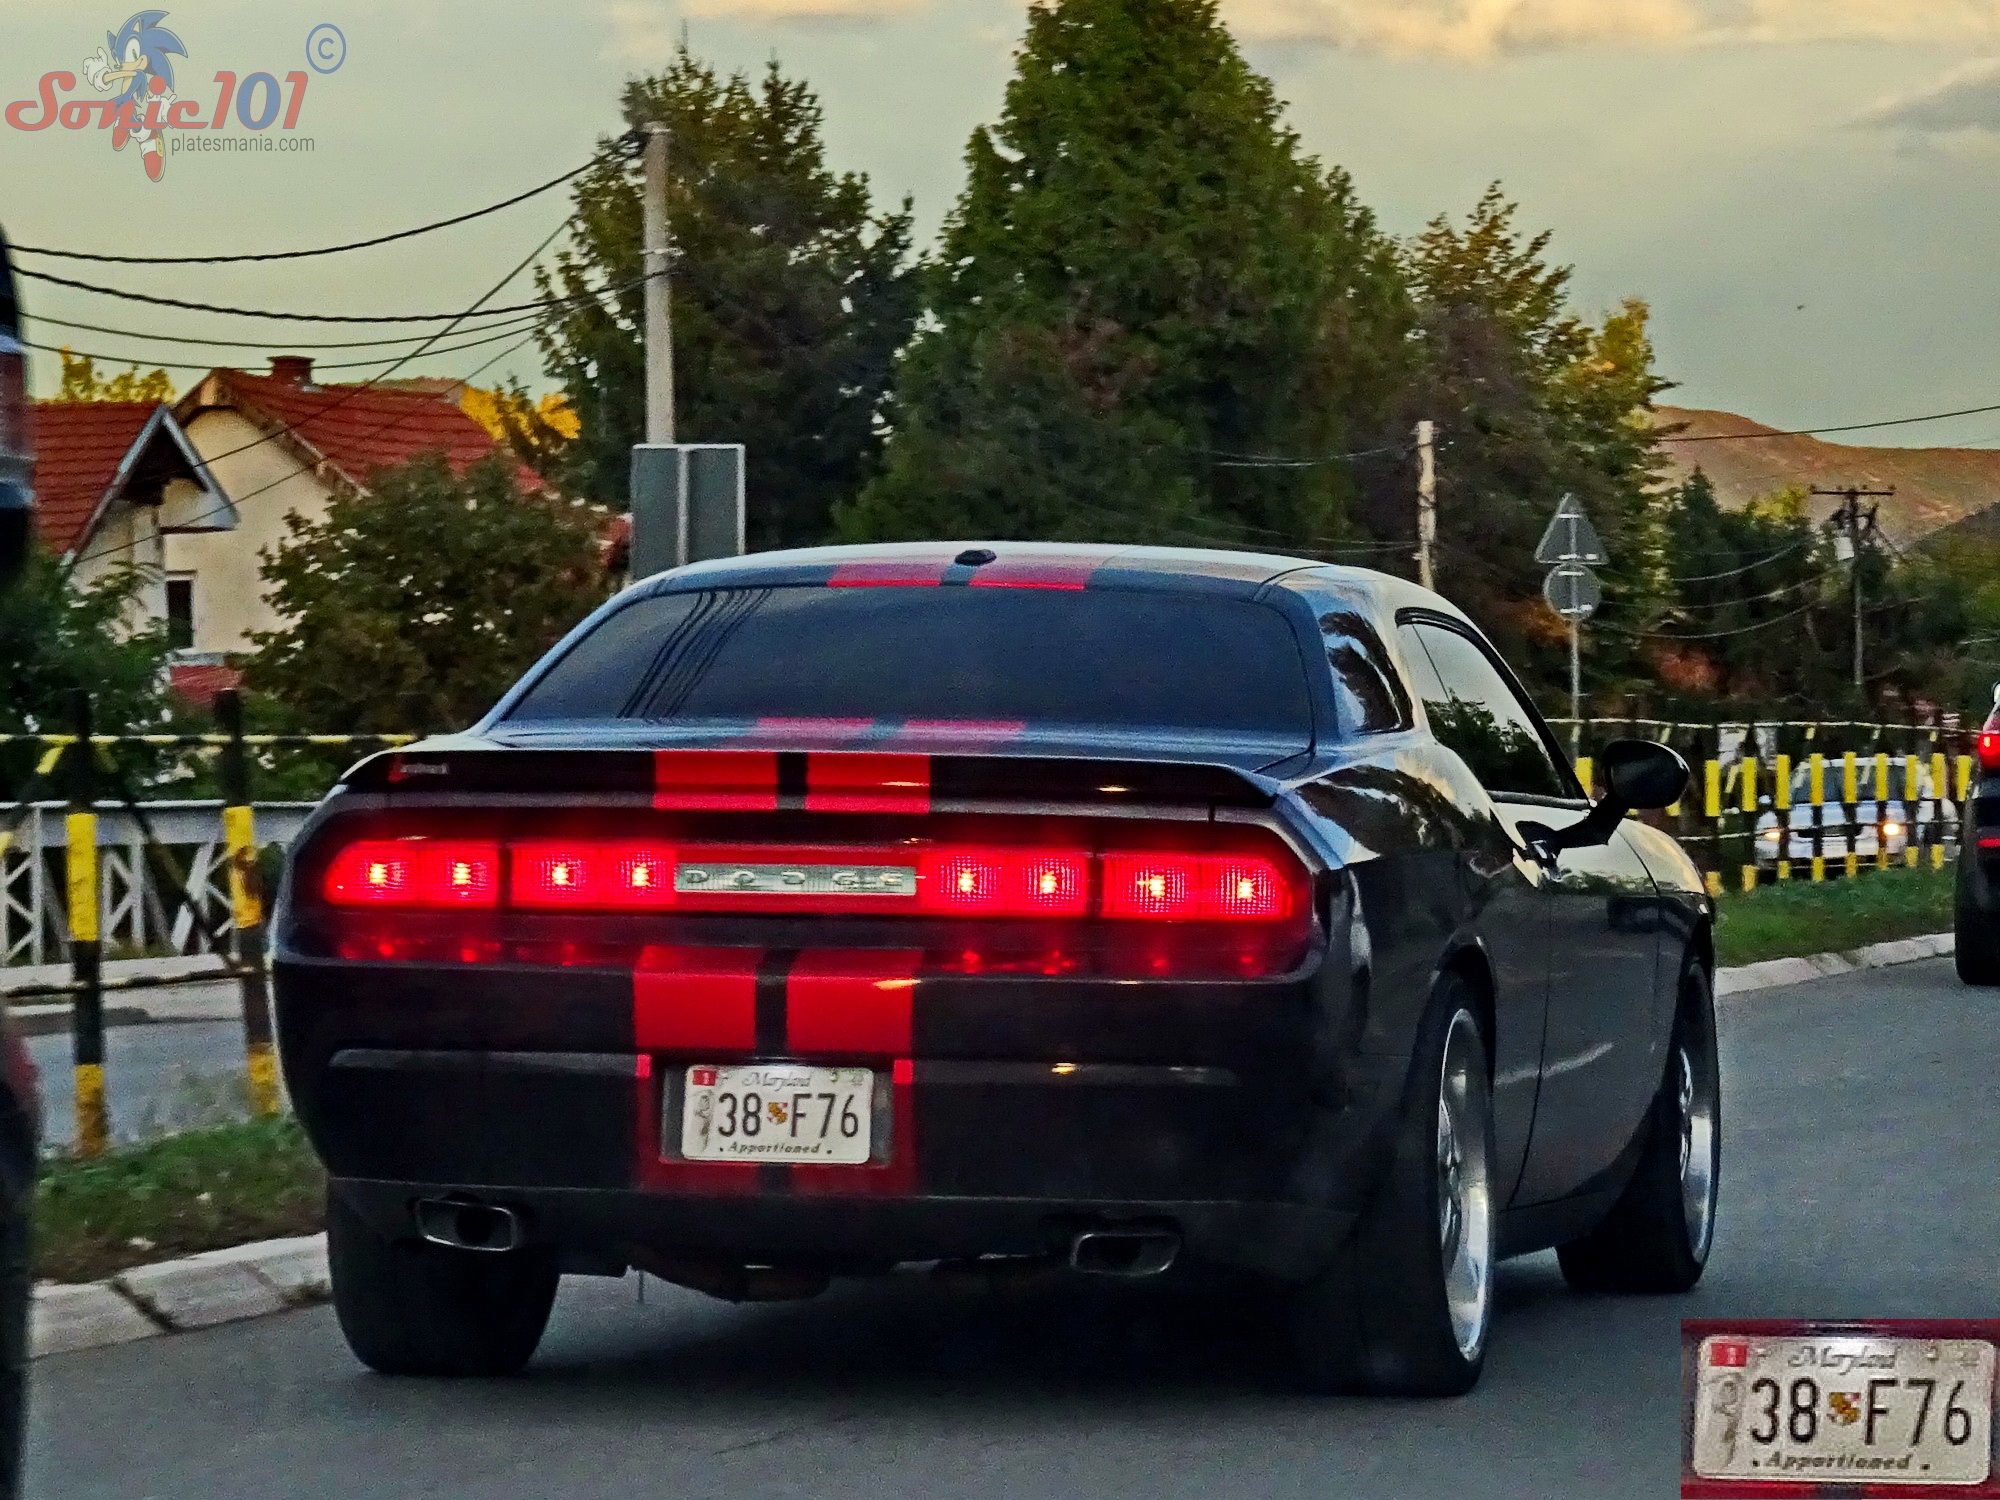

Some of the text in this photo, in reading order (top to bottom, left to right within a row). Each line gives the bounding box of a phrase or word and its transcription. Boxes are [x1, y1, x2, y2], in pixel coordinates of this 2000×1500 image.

[717, 1092, 859, 1138] 38 F76
[728, 1141, 822, 1156] Apportioned
